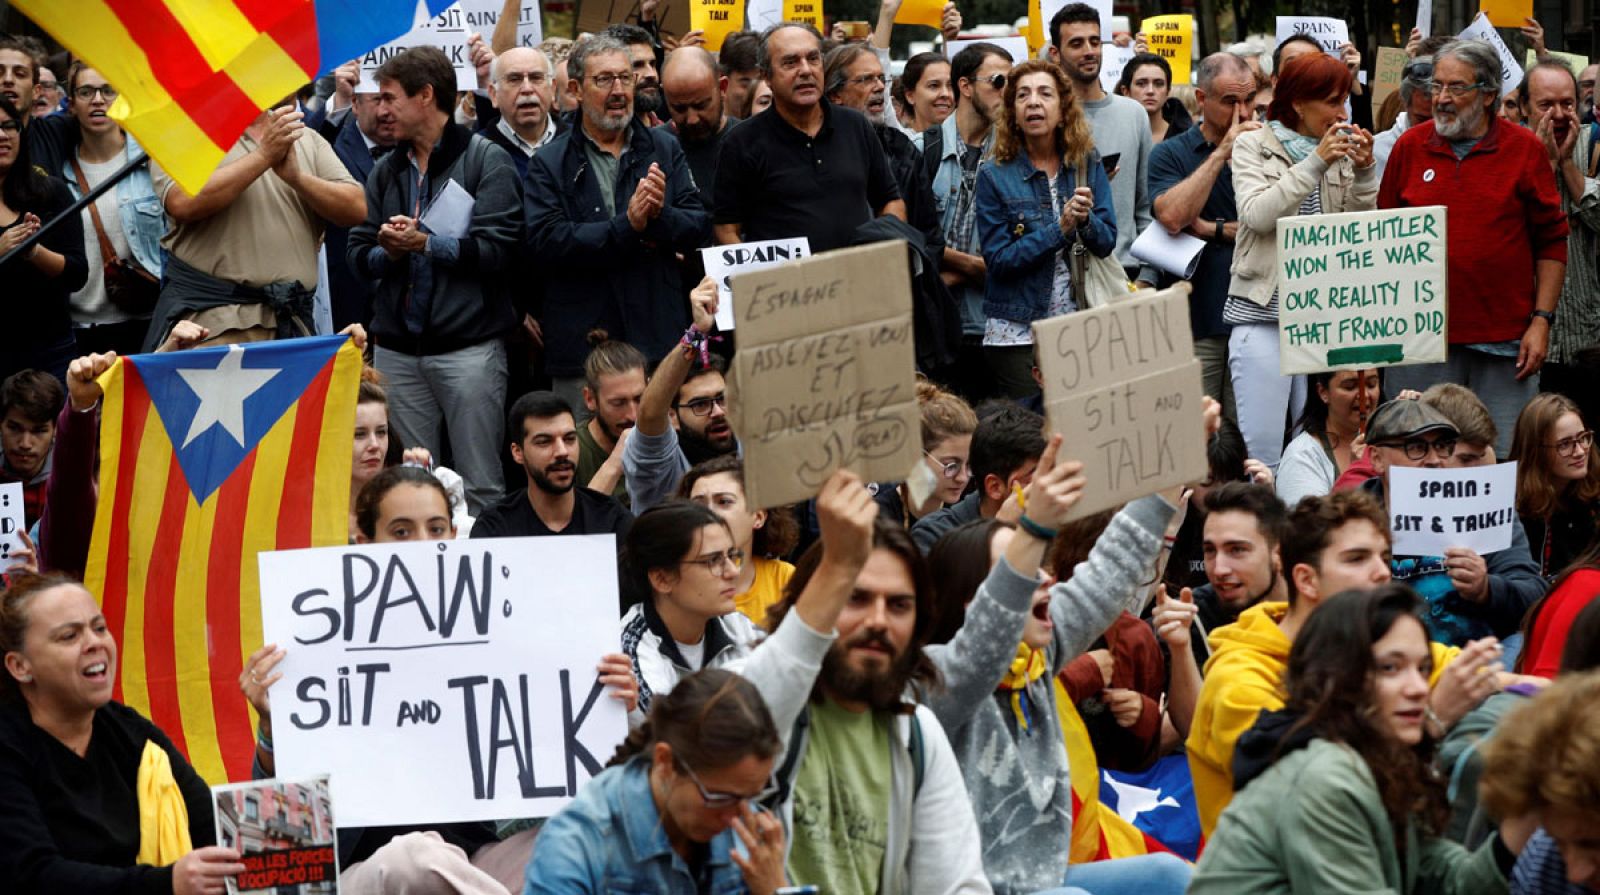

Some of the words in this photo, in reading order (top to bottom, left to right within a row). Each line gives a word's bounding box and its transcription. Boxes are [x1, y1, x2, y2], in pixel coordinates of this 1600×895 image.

[466, 12, 497, 26] AIN
[709, 10, 729, 21] TALK
[794, 4, 813, 13] SPAIN
[1154, 22, 1179, 31] SPAIN
[1293, 22, 1336, 34] SPAIN:
[1151, 34, 1165, 44] SIT
[1166, 33, 1182, 45] AND
[1323, 40, 1342, 51] ND
[1156, 49, 1175, 57] TALK
[1284, 221, 1363, 249] IMAGINE
[1368, 214, 1438, 242] HITLER
[1284, 255, 1327, 279] WON
[1336, 250, 1374, 270] THE
[1384, 242, 1434, 265] WAR
[1285, 288, 1323, 311] OUR
[1328, 281, 1400, 309] REALITY
[1414, 280, 1434, 303] IS
[1284, 322, 1332, 346] THAT
[1339, 316, 1408, 343] FRANCO
[1057, 301, 1174, 390] SPAIN
[810, 356, 855, 393] ET
[1155, 393, 1183, 412] AND
[1098, 423, 1175, 490] TALK
[1393, 514, 1423, 531] SIT
[1431, 516, 1444, 533] &
[1452, 507, 1513, 533] TALK!!
[397, 700, 441, 727] AND
[448, 669, 607, 800] TALK
